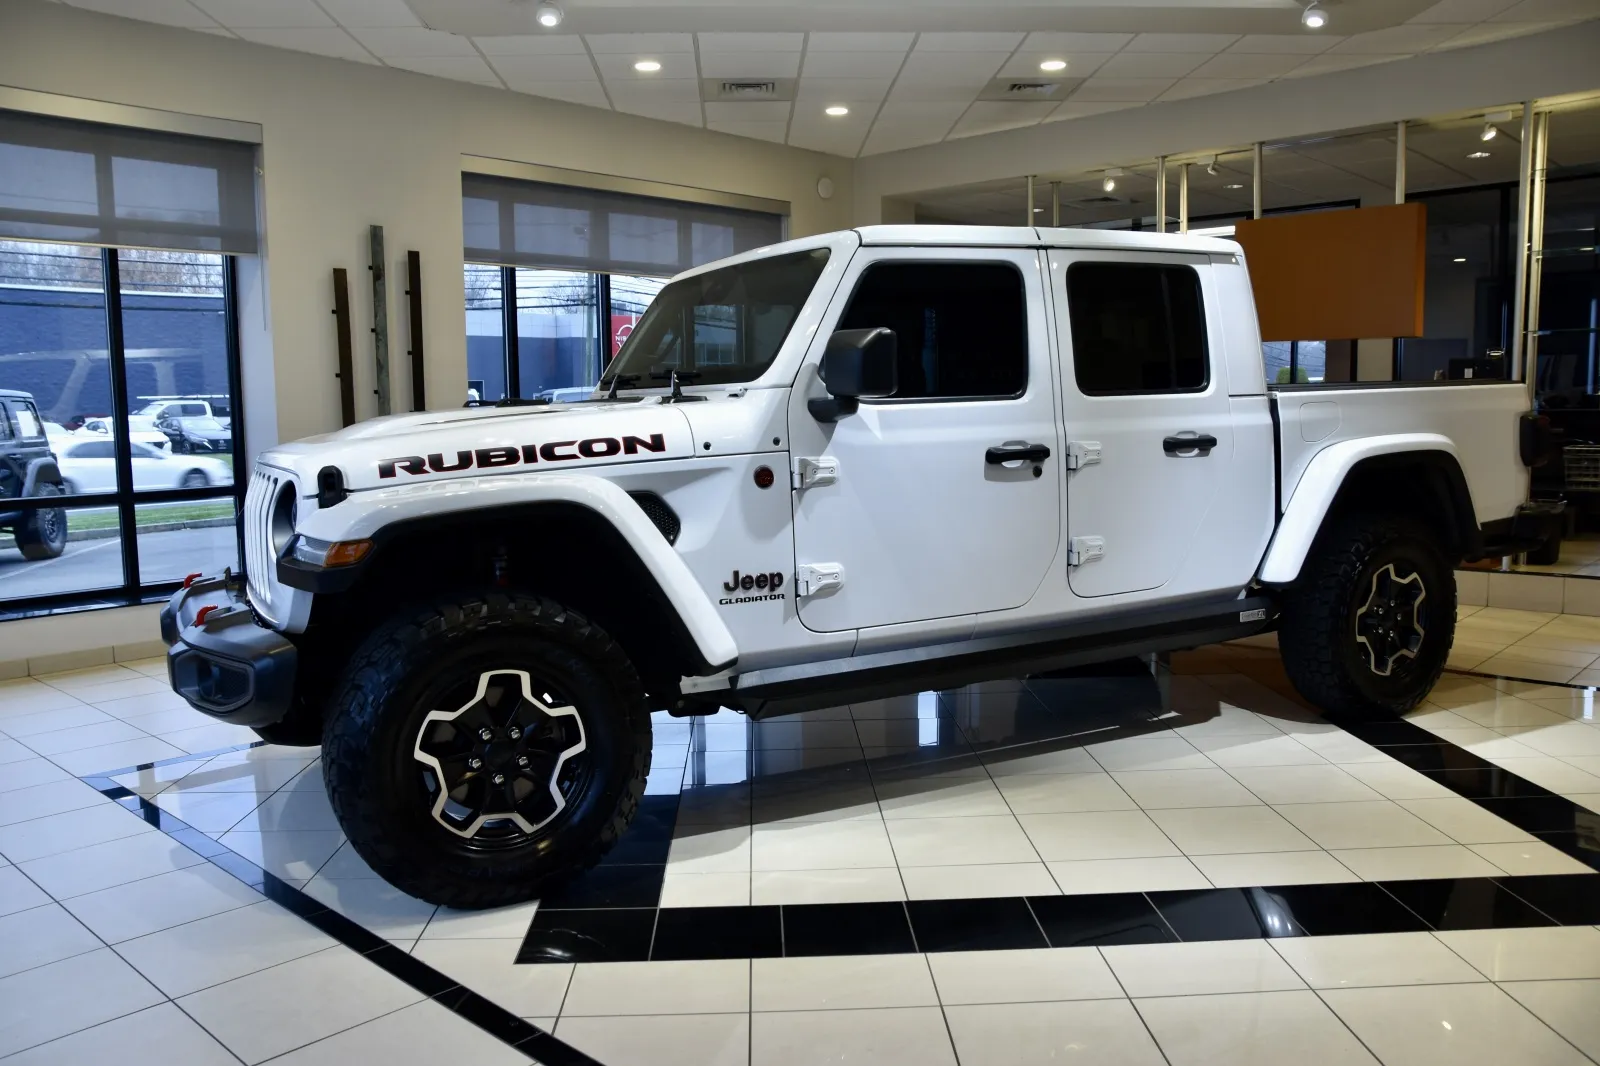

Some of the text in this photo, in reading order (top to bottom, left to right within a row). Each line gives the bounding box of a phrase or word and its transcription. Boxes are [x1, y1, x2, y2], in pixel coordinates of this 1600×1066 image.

[378, 433, 666, 479] RUBICON
[723, 570, 784, 592] Jeep
[719, 593, 785, 605] GLADIATOR
